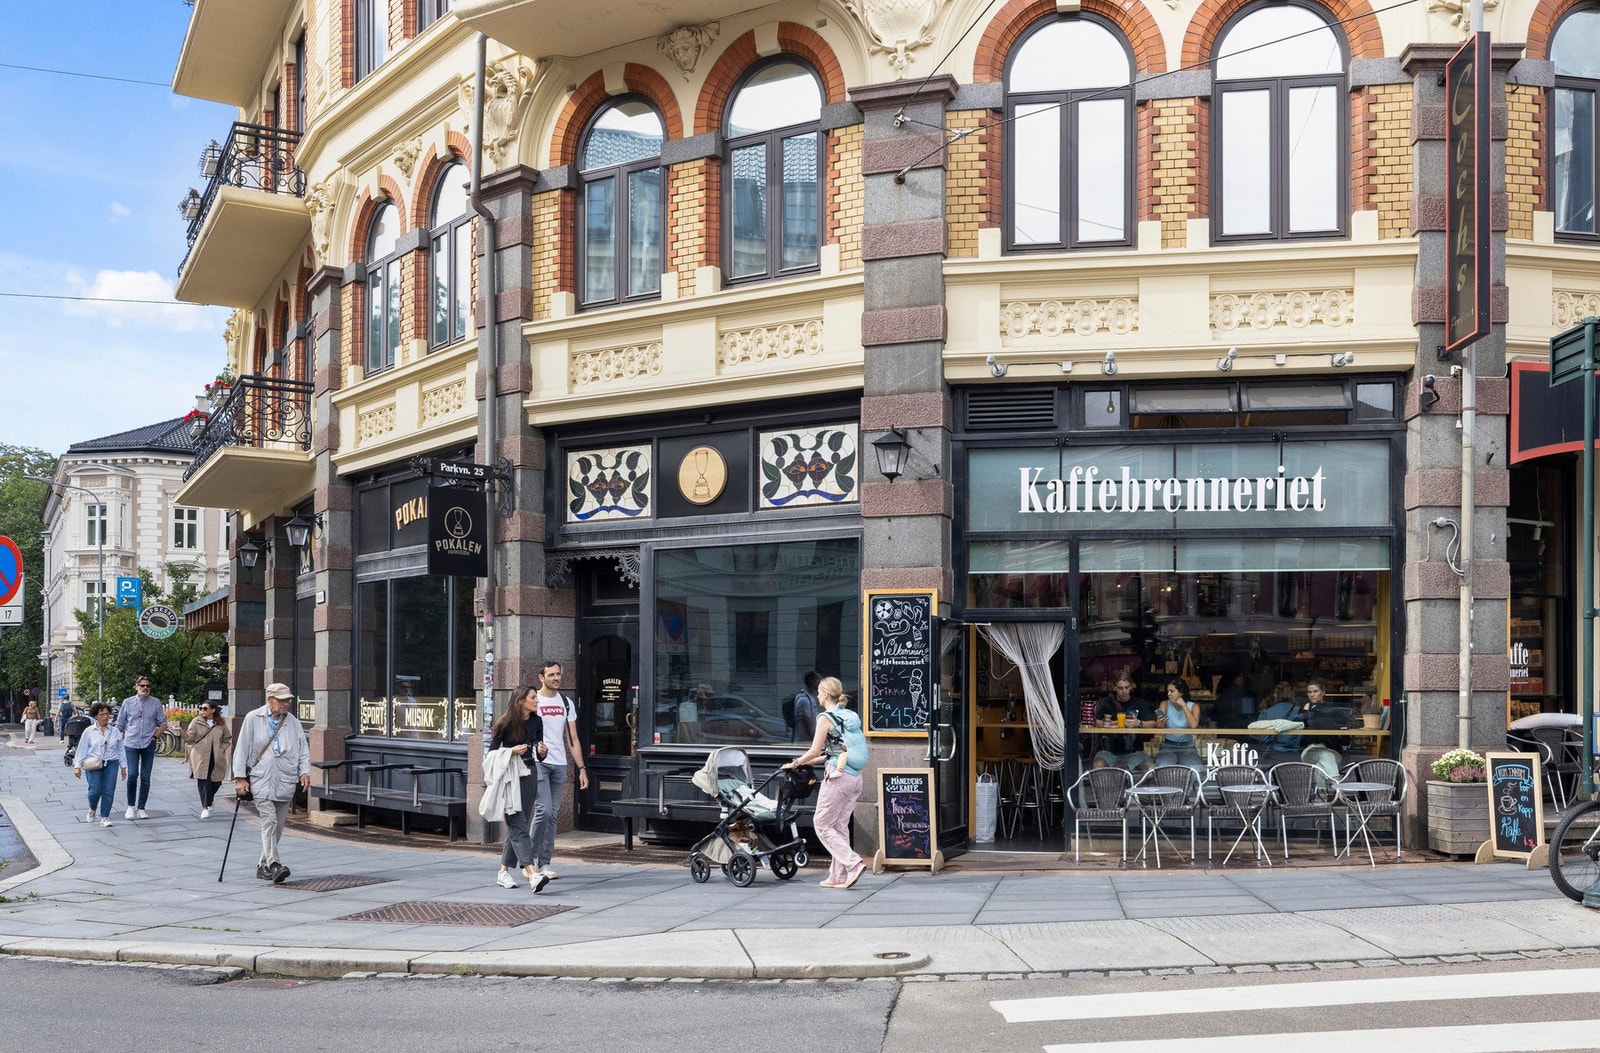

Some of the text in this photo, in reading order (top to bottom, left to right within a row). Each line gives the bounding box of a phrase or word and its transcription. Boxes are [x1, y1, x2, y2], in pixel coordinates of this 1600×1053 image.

[1451, 62, 1473, 293] Cochs
[440, 462, 484, 476] Parkvn. 25
[1018, 465, 1327, 514] Kaffebrenneriet
[435, 538, 482, 555] POKALEN
[4, 609, 12, 619] 17
[144, 606, 175, 620] ESPRESSO
[146, 627, 173, 637] HOUSE
[362, 706, 385, 725] SPORT
[405, 708, 434, 728] MUSIKK
[890, 706, 913, 728] 45
[1206, 742, 1259, 767] Kaffe
